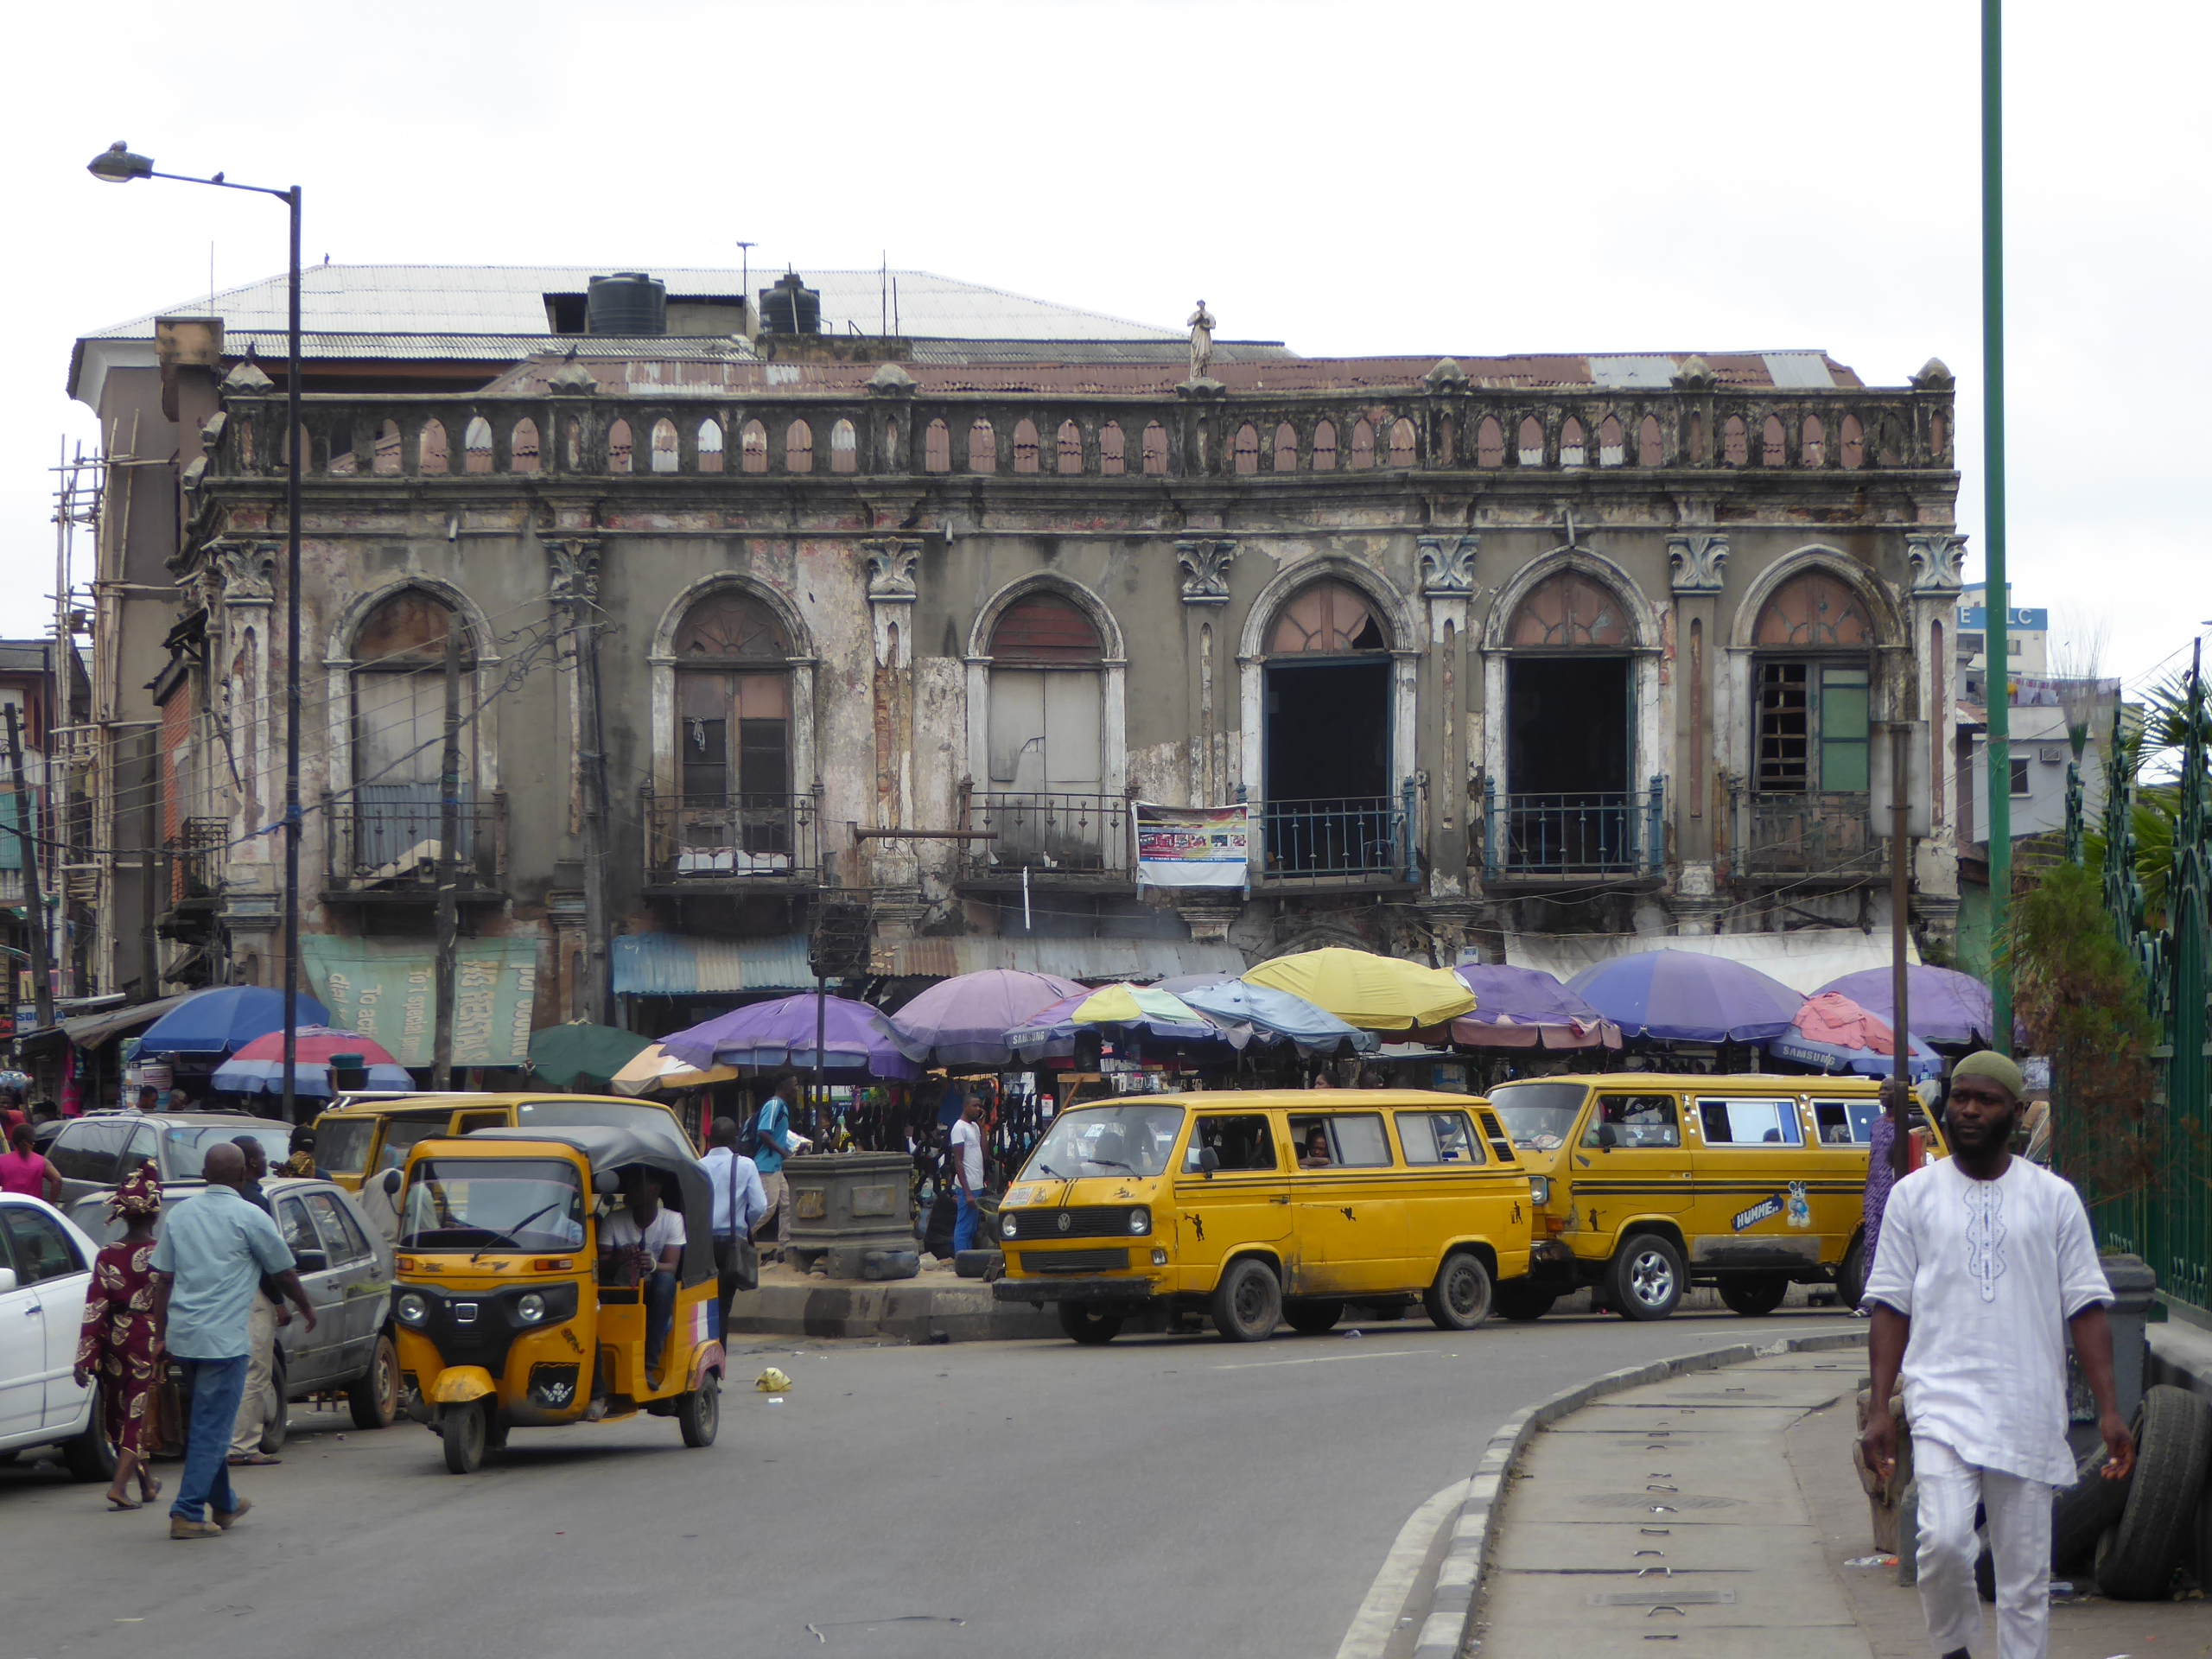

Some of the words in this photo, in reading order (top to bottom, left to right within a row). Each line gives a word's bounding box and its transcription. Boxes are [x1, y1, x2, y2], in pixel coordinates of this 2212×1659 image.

[408, 967, 432, 984] To
[328, 973, 351, 1004] dial
[359, 983, 382, 1006] To
[357, 1008, 378, 1036] acti
[402, 995, 426, 1035] special
[1013, 1031, 1045, 1045] SAMSUNG
[1783, 1046, 1836, 1065] SAMSUNG
